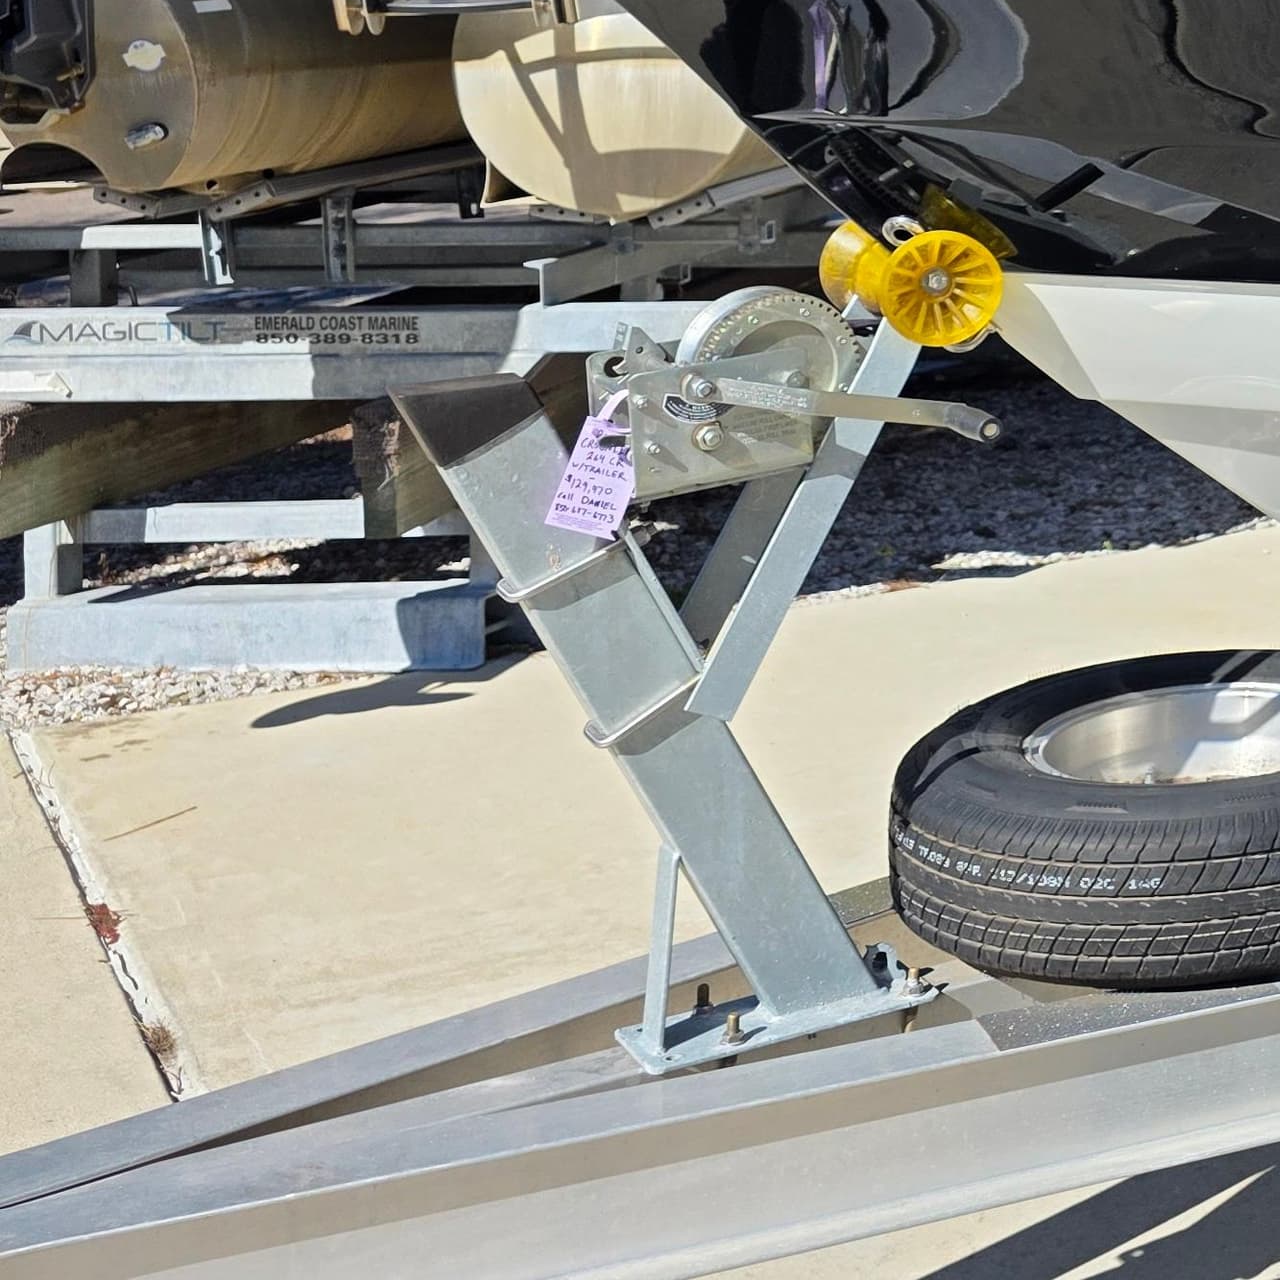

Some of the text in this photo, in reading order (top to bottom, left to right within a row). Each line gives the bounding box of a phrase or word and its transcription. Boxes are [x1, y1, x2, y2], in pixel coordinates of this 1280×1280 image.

[254, 315, 419, 331] EMERALD COAST MARINE
[38, 321, 226, 344] MAGICTILT
[255, 332, 419, 344] 850-389-8318
